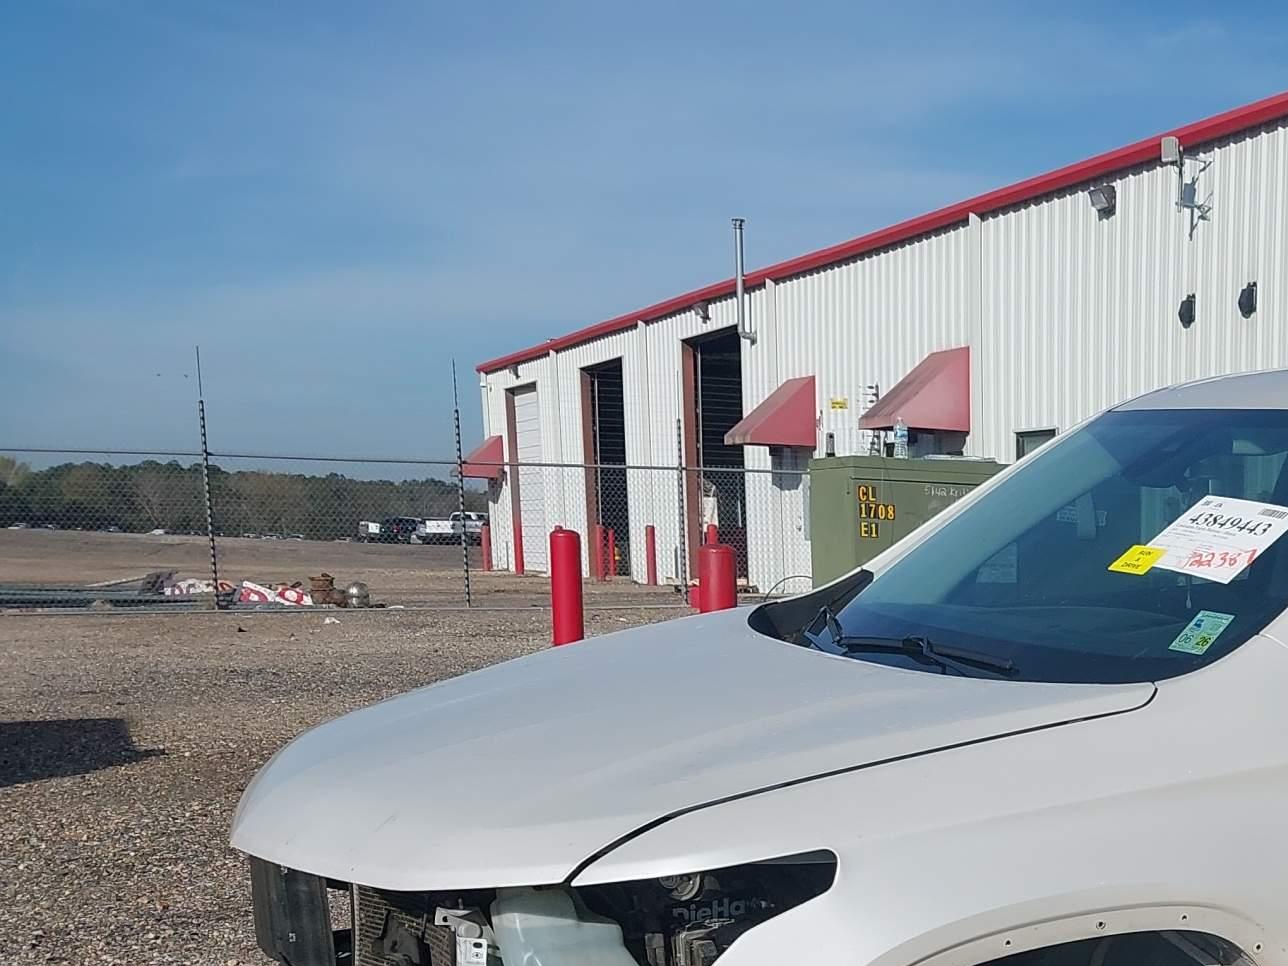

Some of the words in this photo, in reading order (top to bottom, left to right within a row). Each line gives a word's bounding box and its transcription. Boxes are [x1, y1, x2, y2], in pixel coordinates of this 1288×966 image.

[858, 485, 877, 502] CL
[859, 503, 895, 520] 1708
[860, 521, 879, 538] E1
[1189, 511, 1273, 536] 43849443
[1178, 633, 1194, 644] 06
[1195, 636, 1212, 648] 26
